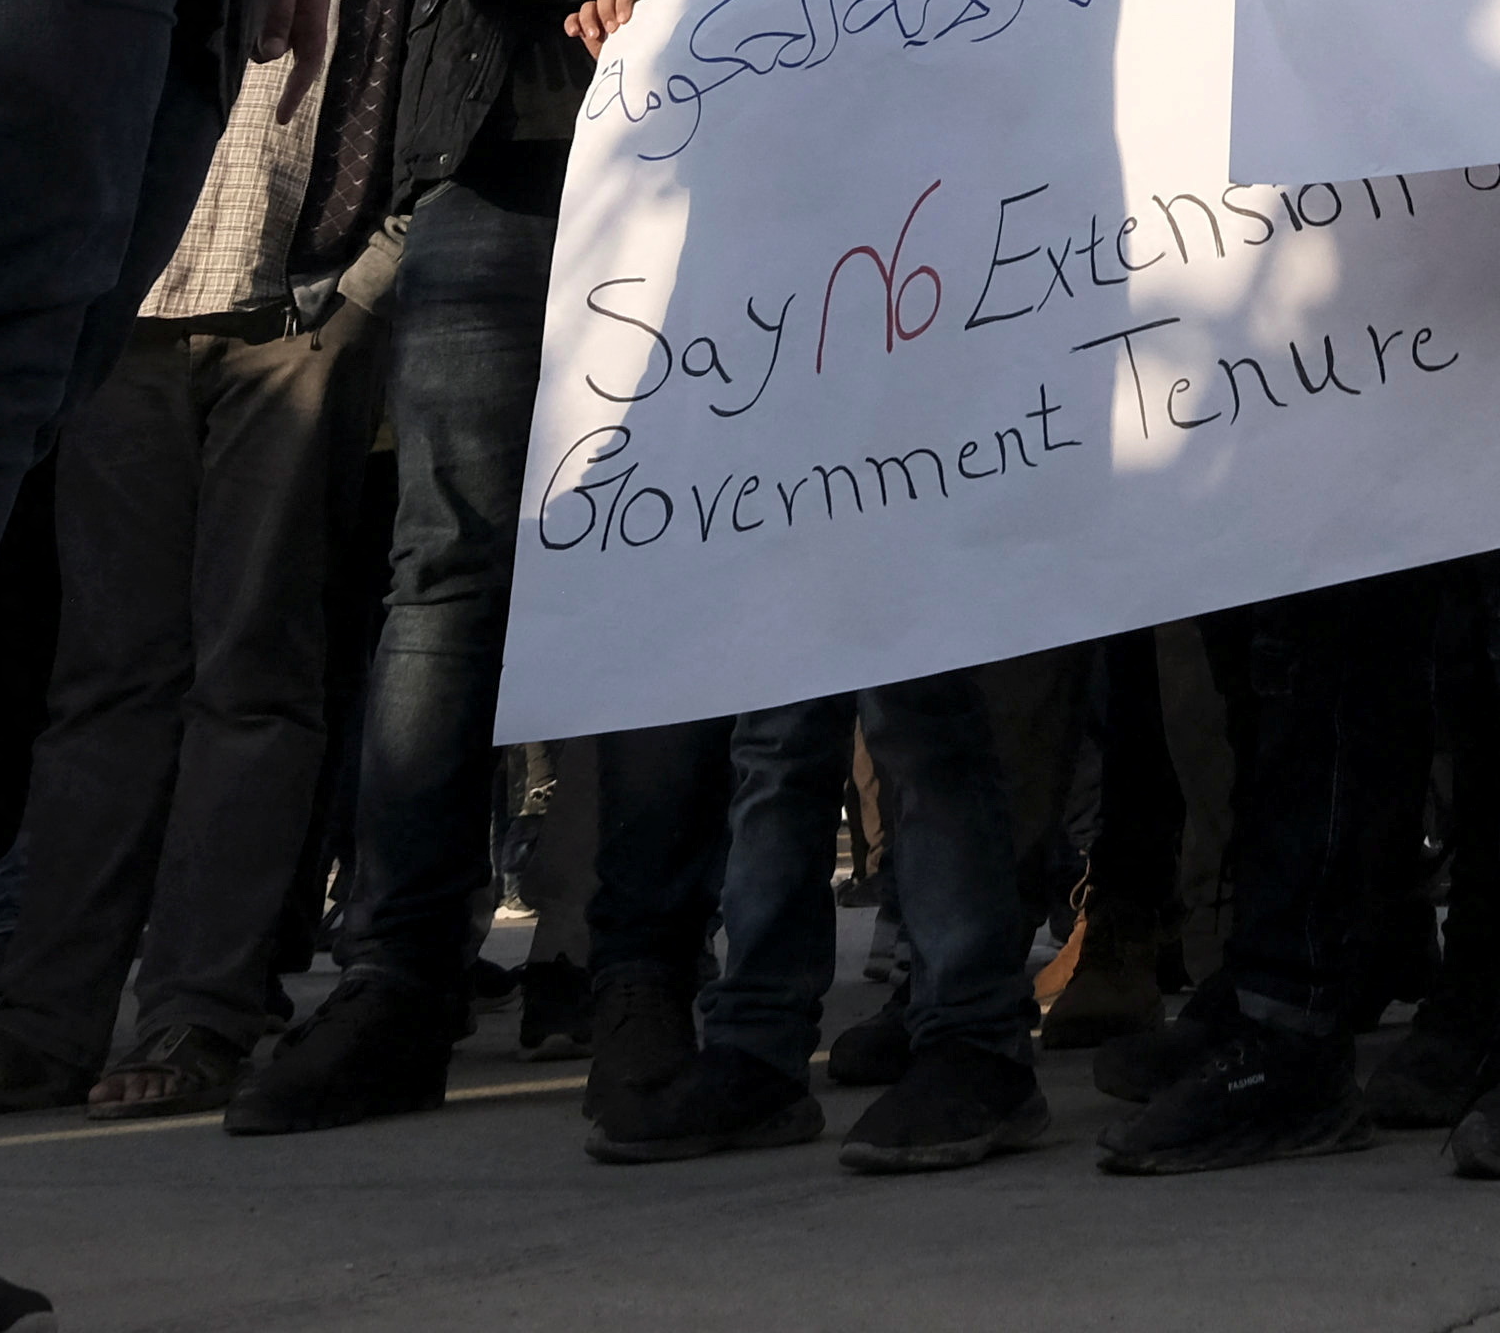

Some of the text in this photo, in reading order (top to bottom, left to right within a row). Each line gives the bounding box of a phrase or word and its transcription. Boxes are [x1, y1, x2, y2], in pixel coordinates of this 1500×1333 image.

[585, 277, 797, 420] Say
[815, 179, 943, 375] No
[963, 174, 1415, 332] Extension
[537, 317, 1459, 554] Government Tenure
[1228, 1072, 1265, 1091] FASHION
